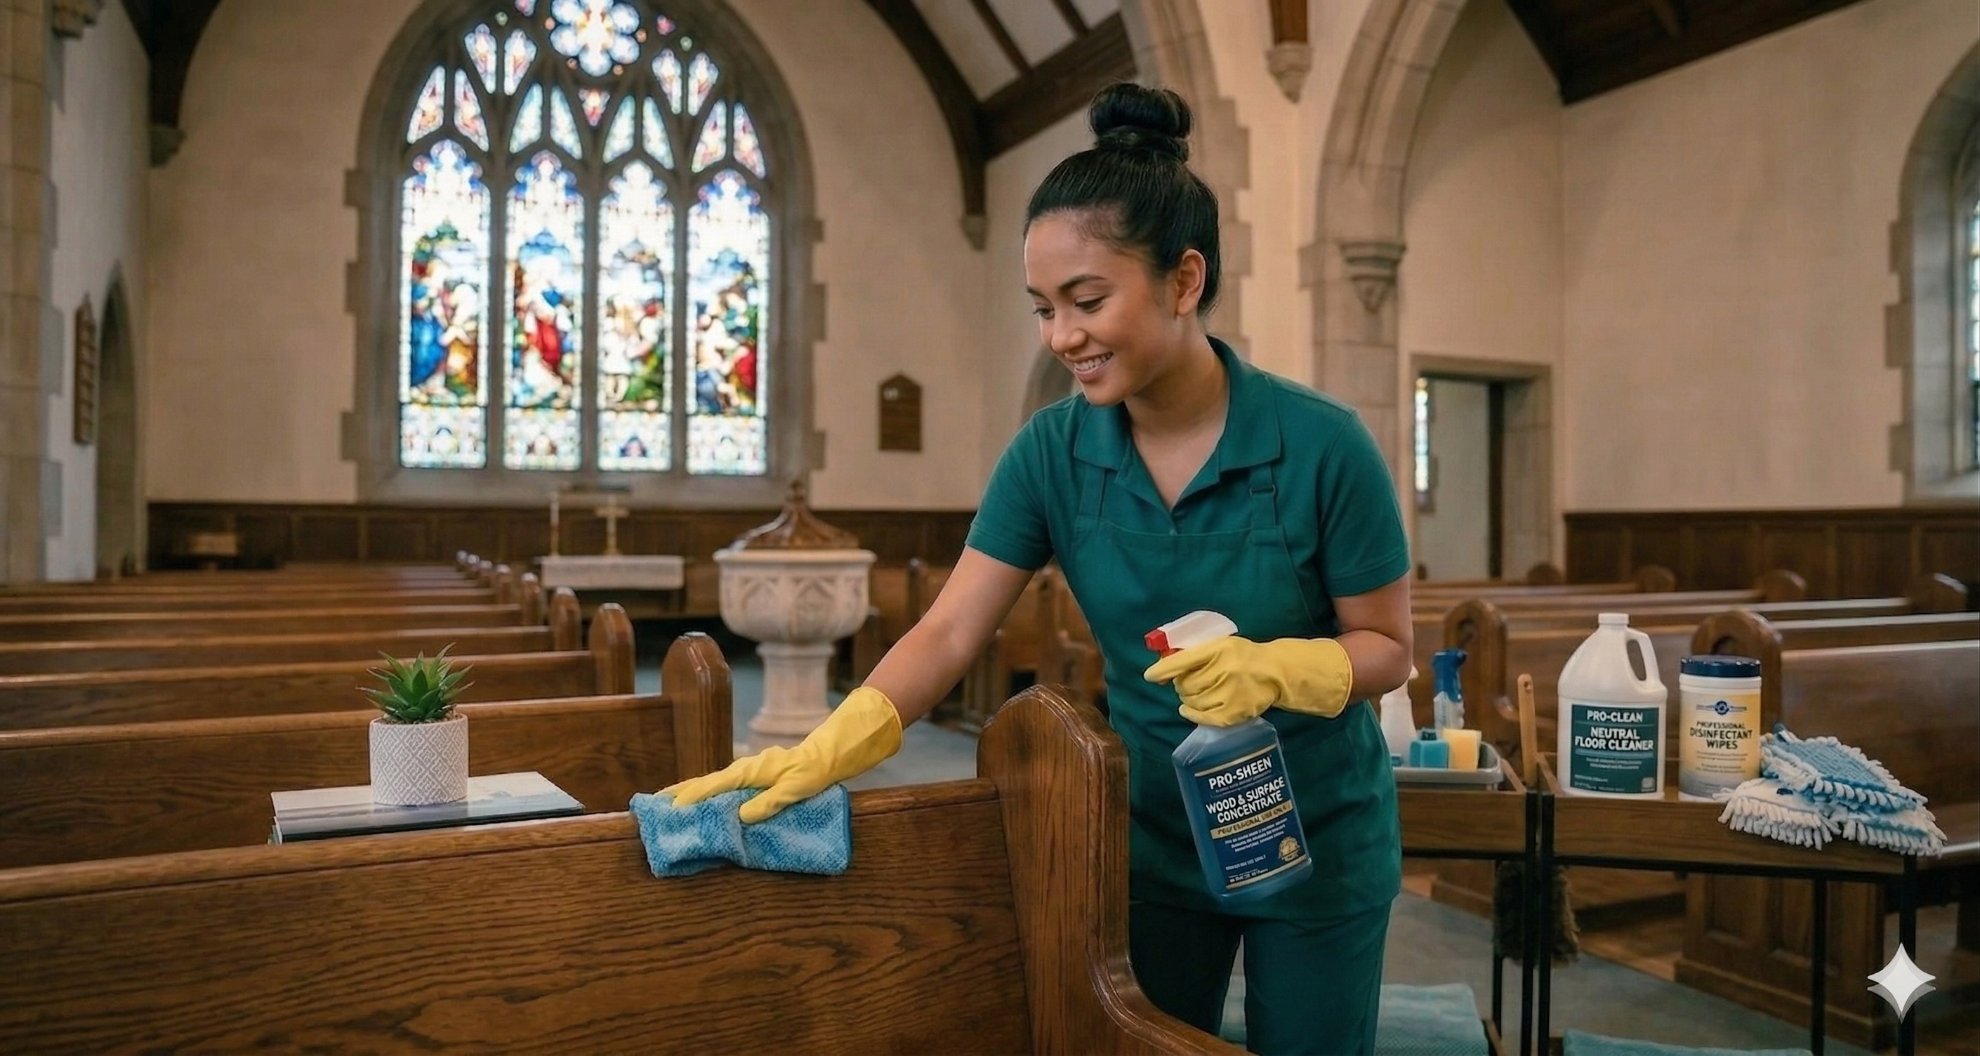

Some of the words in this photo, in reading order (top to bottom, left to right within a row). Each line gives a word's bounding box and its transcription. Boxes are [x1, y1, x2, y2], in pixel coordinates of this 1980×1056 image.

[1587, 710, 1643, 723] PRO-CLEAN
[1591, 726, 1640, 740] NEUTRAL
[1689, 727, 1753, 740] DISINFECTANT
[1574, 735, 1607, 750] FLOOR
[1608, 739, 1654, 751] CLEANER
[1706, 739, 1738, 750] WIPES
[1208, 756, 1272, 790] PRO-SHEEN
[1205, 797, 1237, 815] WOOD
[1238, 794, 1246, 805] &
[1246, 776, 1286, 802] SURFACE
[1217, 790, 1283, 823] CONCENTRATE
